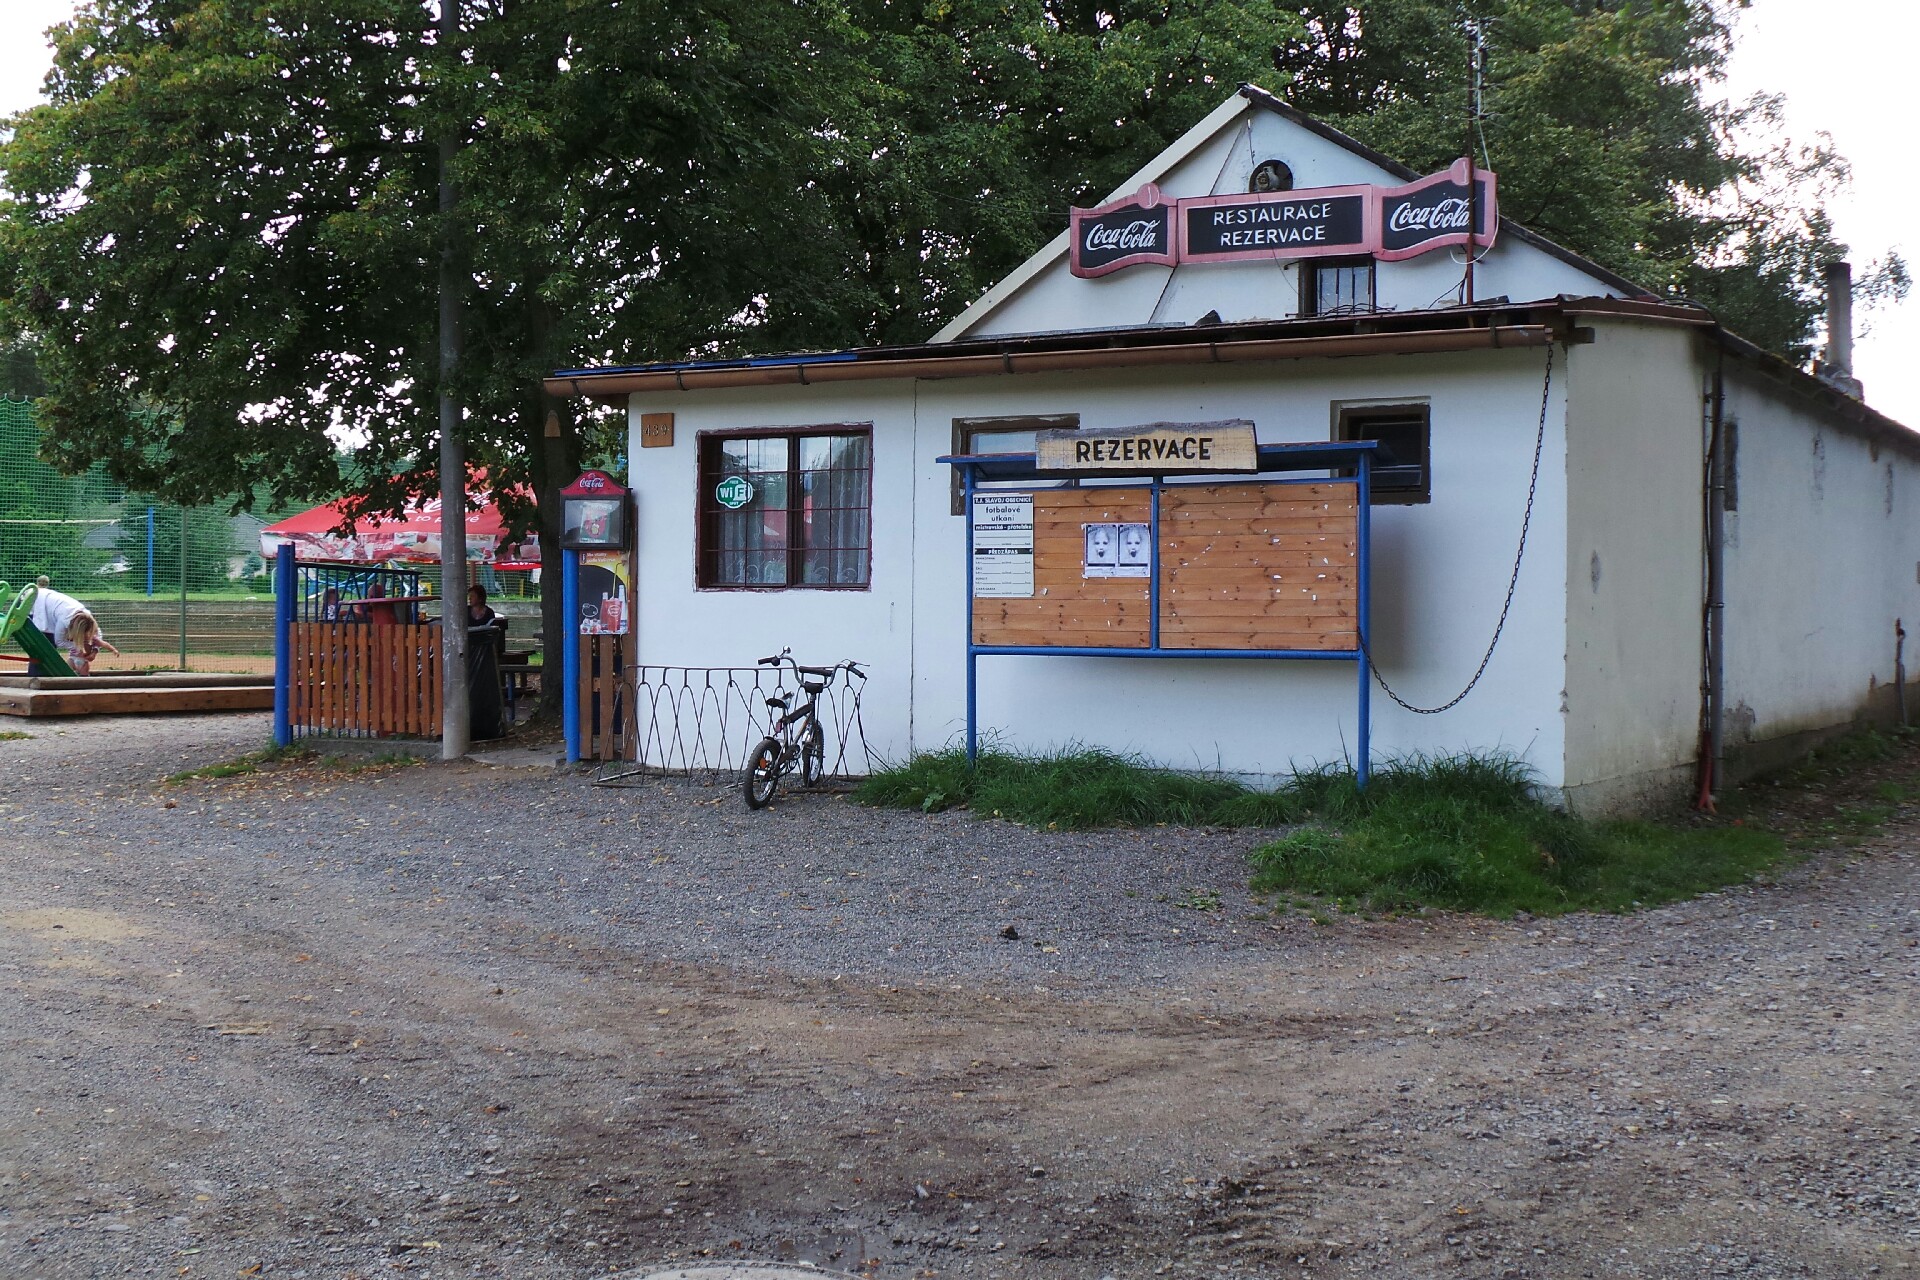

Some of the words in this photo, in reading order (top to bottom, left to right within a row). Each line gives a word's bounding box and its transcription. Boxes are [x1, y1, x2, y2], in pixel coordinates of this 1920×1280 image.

[1213, 202, 1332, 226] RESTAURACE
[1391, 198, 1476, 231] Coca-Cola
[1086, 219, 1161, 251] Coca-Cola
[1220, 225, 1326, 246] REZERVACE
[644, 424, 668, 437] 439
[1076, 437, 1213, 463] REZERVACE
[580, 477, 605, 488] Coca-Cola
[985, 505, 1021, 514] fotbalové
